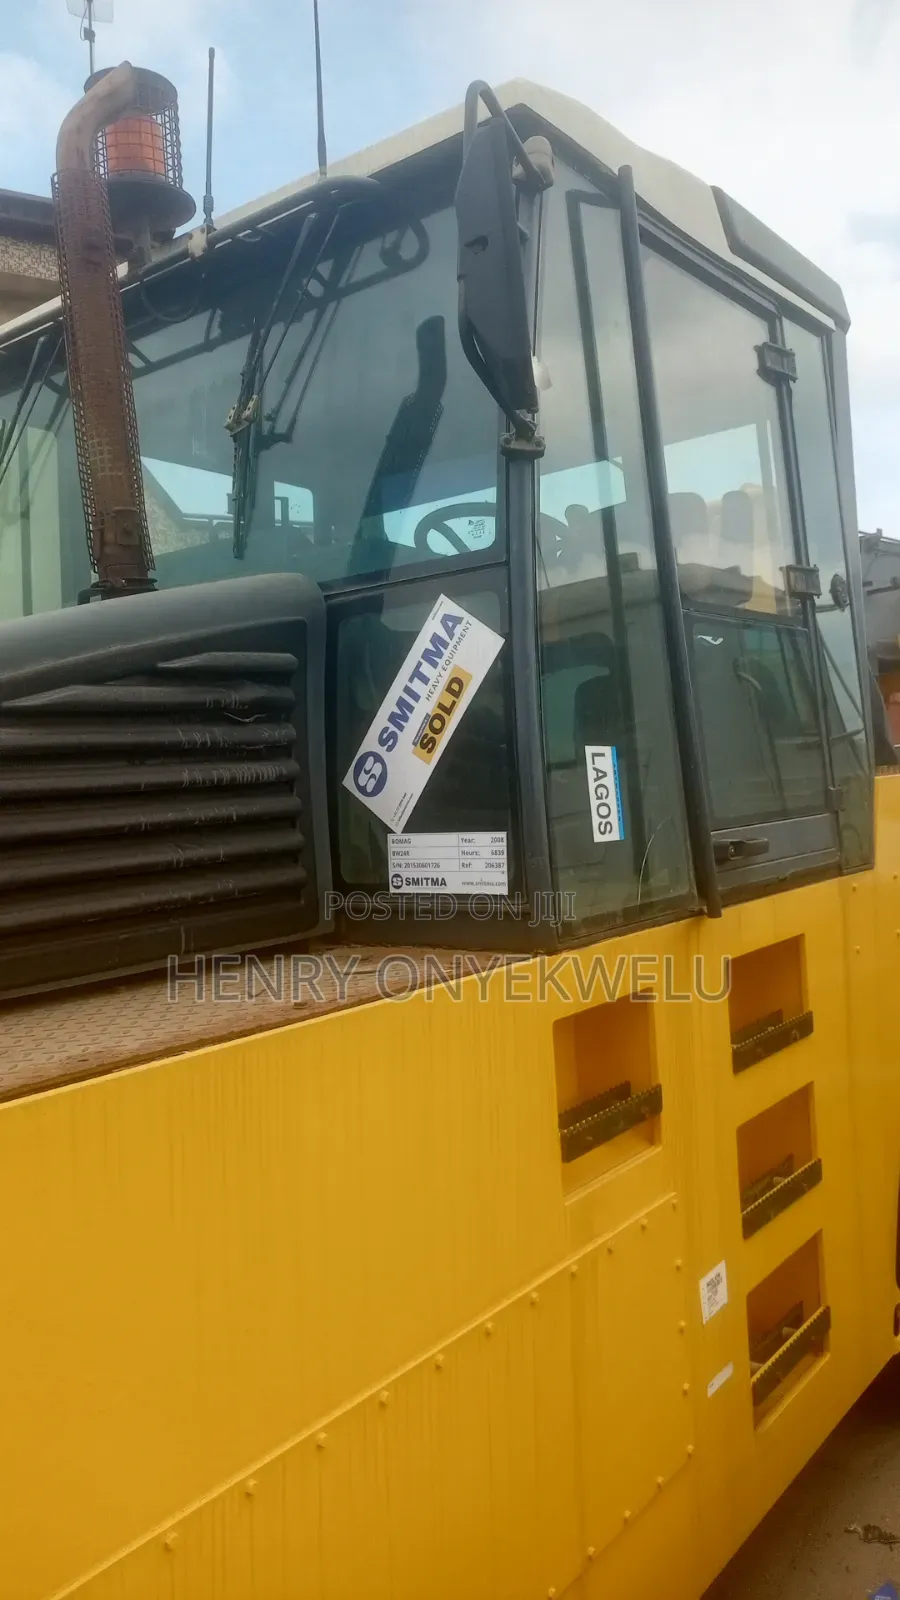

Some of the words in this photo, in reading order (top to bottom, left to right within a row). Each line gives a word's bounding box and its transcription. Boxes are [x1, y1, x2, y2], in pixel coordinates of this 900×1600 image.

[378, 613, 465, 753] SMITMA
[425, 673, 443, 702] HEAVY
[441, 620, 472, 672] EQUIPMENT
[419, 676, 464, 754] SOLD
[591, 752, 613, 836] LAGOS
[404, 877, 447, 887] SMITMA
